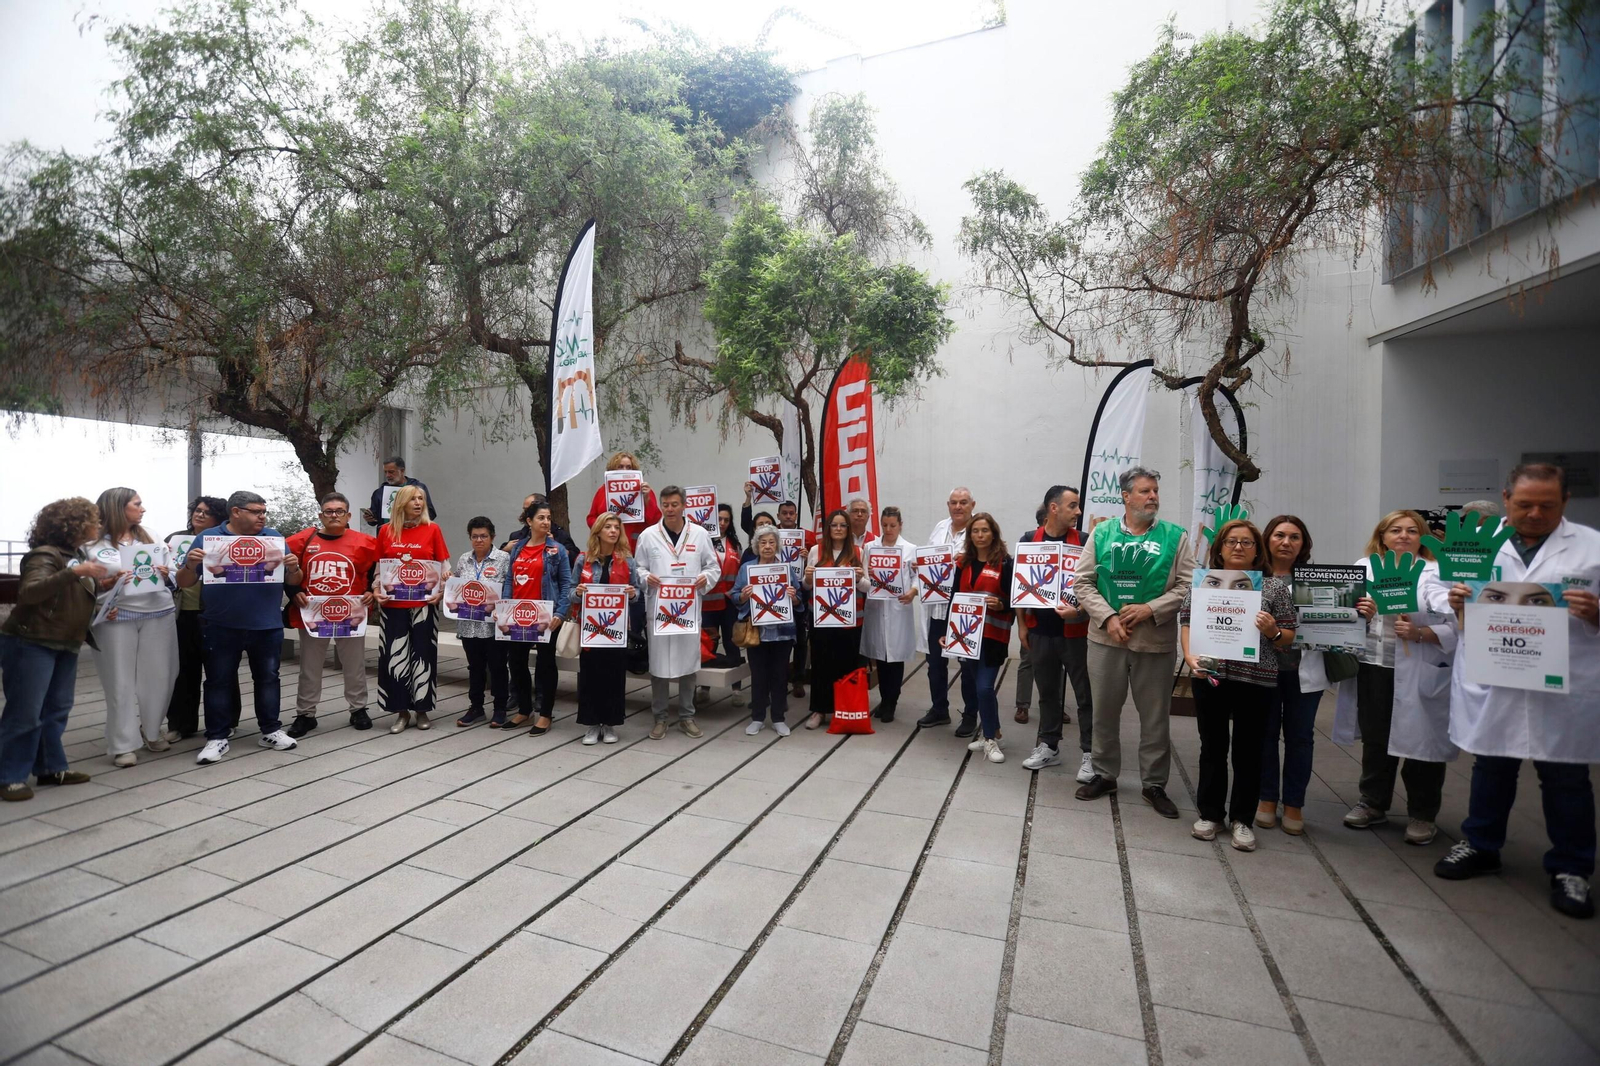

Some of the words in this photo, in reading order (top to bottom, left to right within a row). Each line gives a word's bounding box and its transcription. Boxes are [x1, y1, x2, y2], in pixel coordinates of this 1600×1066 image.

[756, 465, 774, 473] STOP
[759, 472, 779, 488] NO
[610, 481, 637, 491] STOP
[620, 494, 636, 507] NO
[686, 496, 712, 506] STOP
[695, 508, 711, 523] NO
[233, 547, 261, 556] STOP
[870, 557, 897, 567] STOP
[924, 555, 945, 564] STOP
[1026, 554, 1051, 563] STOP
[310, 561, 348, 579] UGT
[401, 570, 423, 578] STOP
[929, 563, 951, 584] NO
[758, 575, 780, 583] STOP
[879, 571, 896, 583] NO
[1030, 564, 1055, 587] NO
[1294, 571, 1364, 580] RECOMENDADO
[1372, 581, 1413, 590] AGRESIONES
[1562, 577, 1594, 586] SATSE
[464, 589, 484, 598] STOP
[661, 587, 692, 598] STOP
[762, 584, 786, 604] NO
[827, 587, 850, 607] NO
[588, 596, 622, 607] STOP
[516, 608, 536, 618] STOP
[670, 602, 688, 618] NO
[958, 605, 977, 613] STOP
[1206, 605, 1246, 614] AGRESIÓN
[598, 611, 617, 628] NO
[960, 614, 979, 635] NO
[1216, 617, 1232, 625] NO
[1487, 624, 1545, 635] AGRESIÓN
[1502, 637, 1526, 648] NO
[1500, 647, 1541, 656] SOLUCIÓN
[835, 710, 863, 720] CCOO
